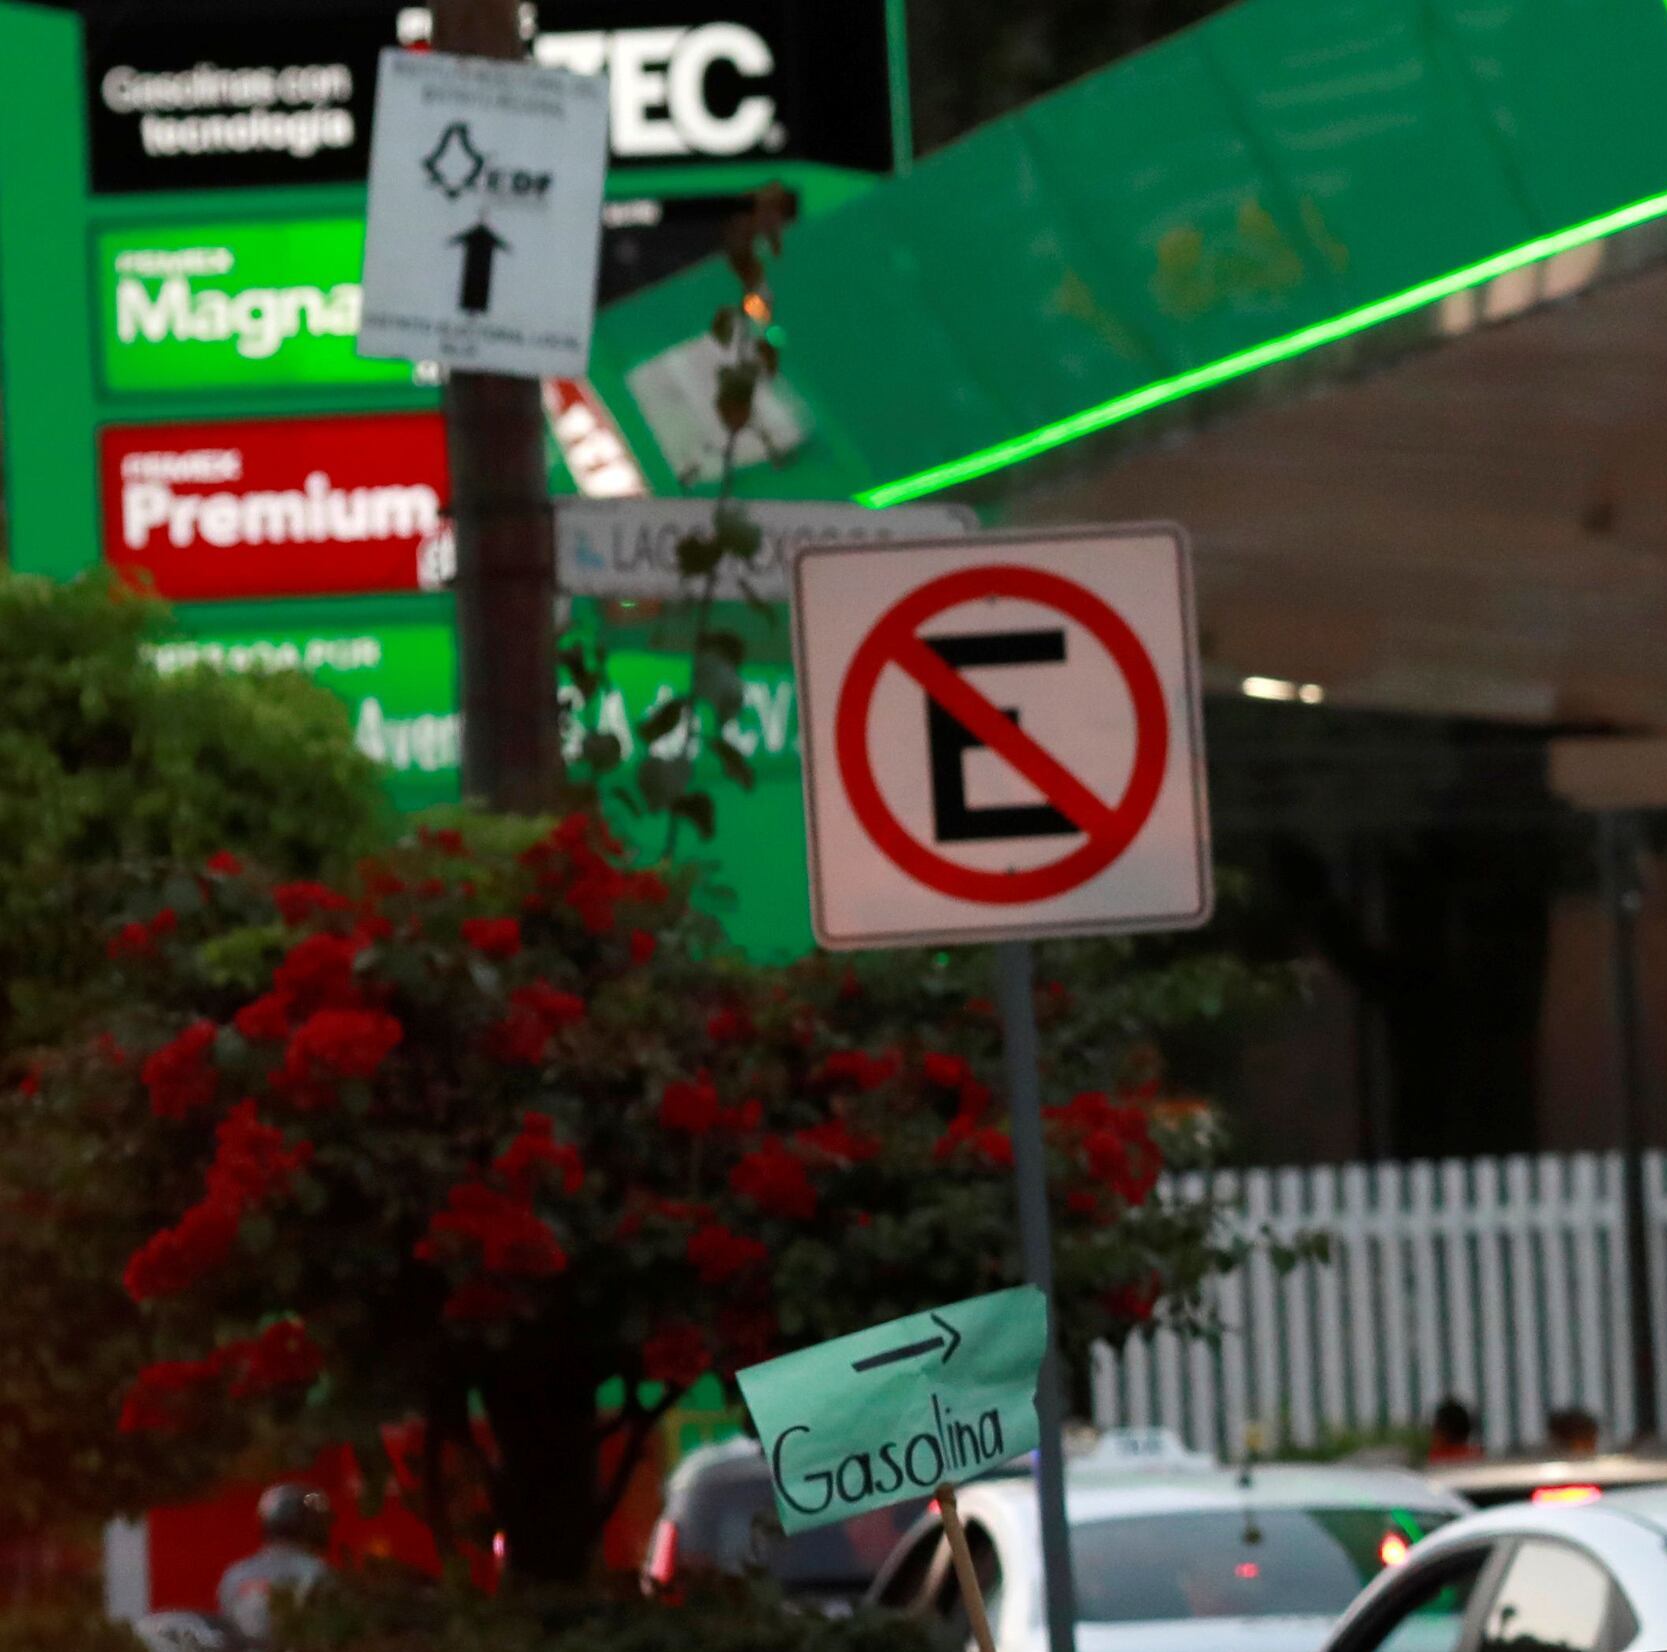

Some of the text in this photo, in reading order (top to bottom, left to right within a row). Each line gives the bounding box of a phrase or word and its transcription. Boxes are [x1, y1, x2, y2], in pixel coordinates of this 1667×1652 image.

[102, 62, 277, 113] Gasolinas
[276, 63, 353, 105] con
[116, 277, 363, 358] Magna
[121, 469, 440, 549] Premium
[920, 628, 1092, 843] E
[772, 1392, 1004, 1515] Gasolina
